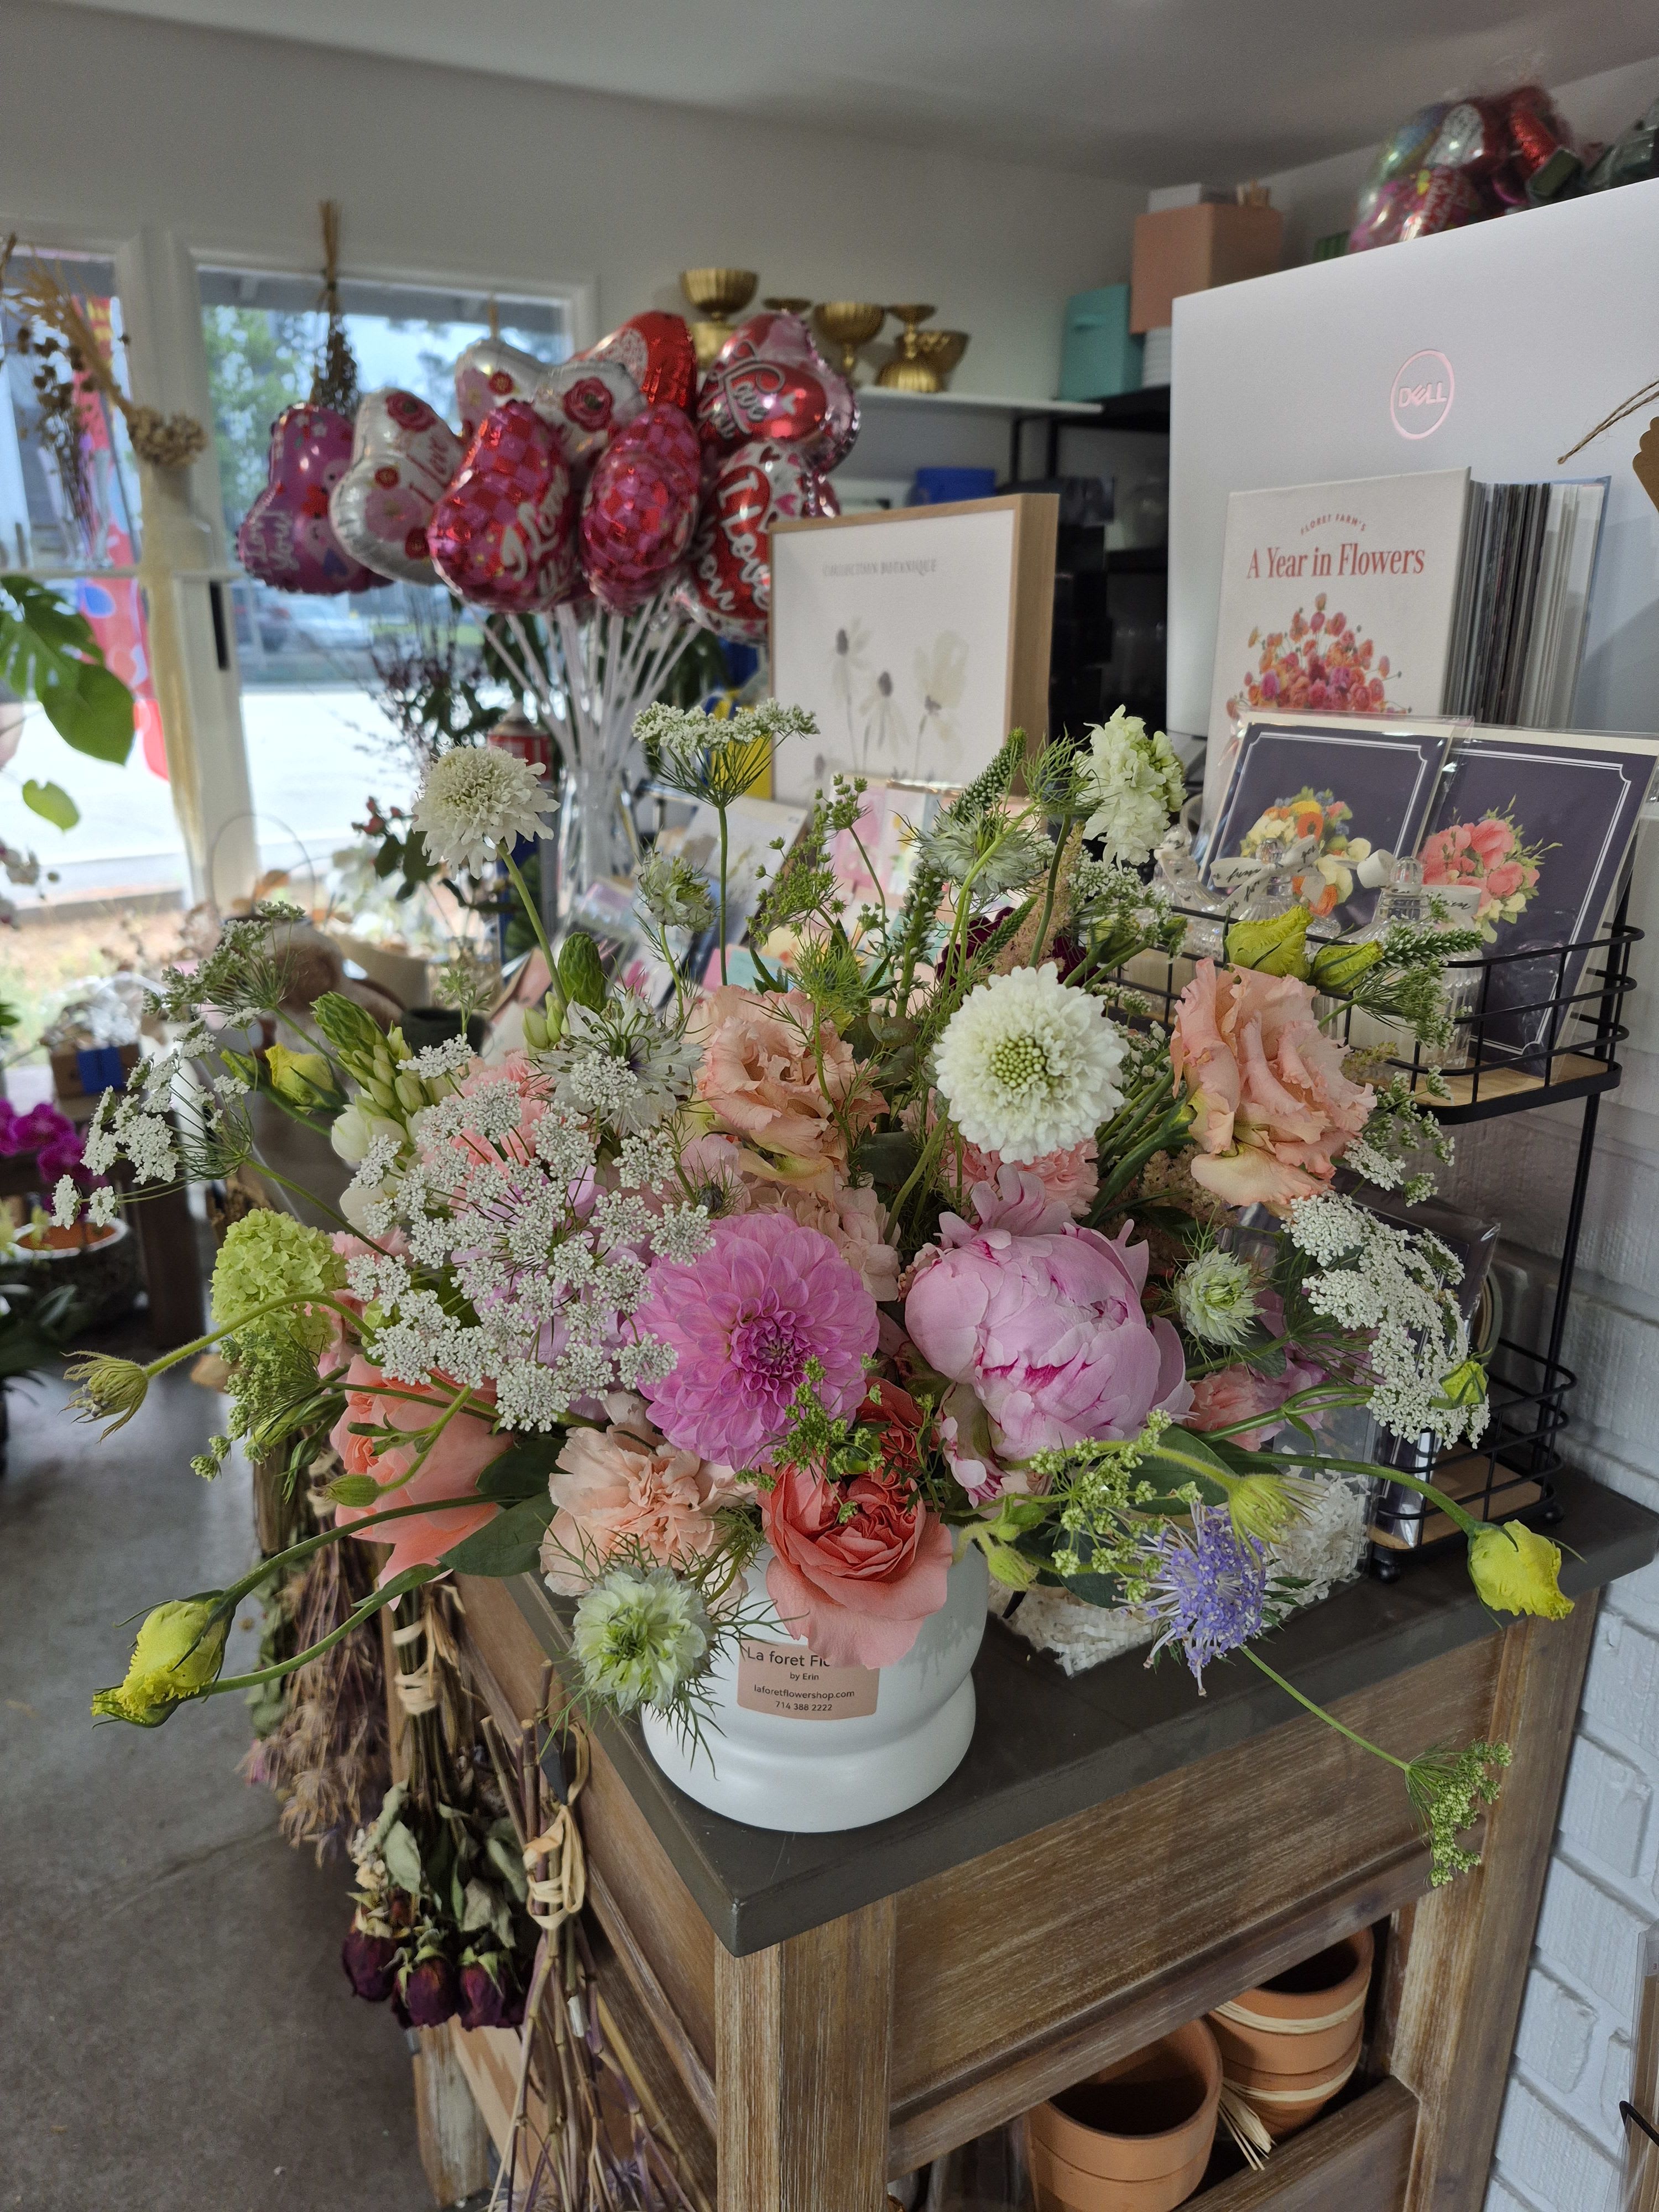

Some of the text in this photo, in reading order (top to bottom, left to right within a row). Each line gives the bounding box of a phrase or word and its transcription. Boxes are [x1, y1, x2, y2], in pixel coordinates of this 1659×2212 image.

[723, 364, 786, 436] Love
[1399, 381, 1448, 408] DELL
[1301, 513, 1366, 535] FLORET FARM'S
[719, 471, 771, 613] I Love
[1246, 543, 1425, 579] A Year in Flowers
[748, 1647, 764, 1661] La
[769, 1650, 805, 1667] foret
[790, 1672, 801, 1681] by
[754, 1684, 855, 1701] laforetflowershop.com
[776, 1701, 791, 1710] 714
